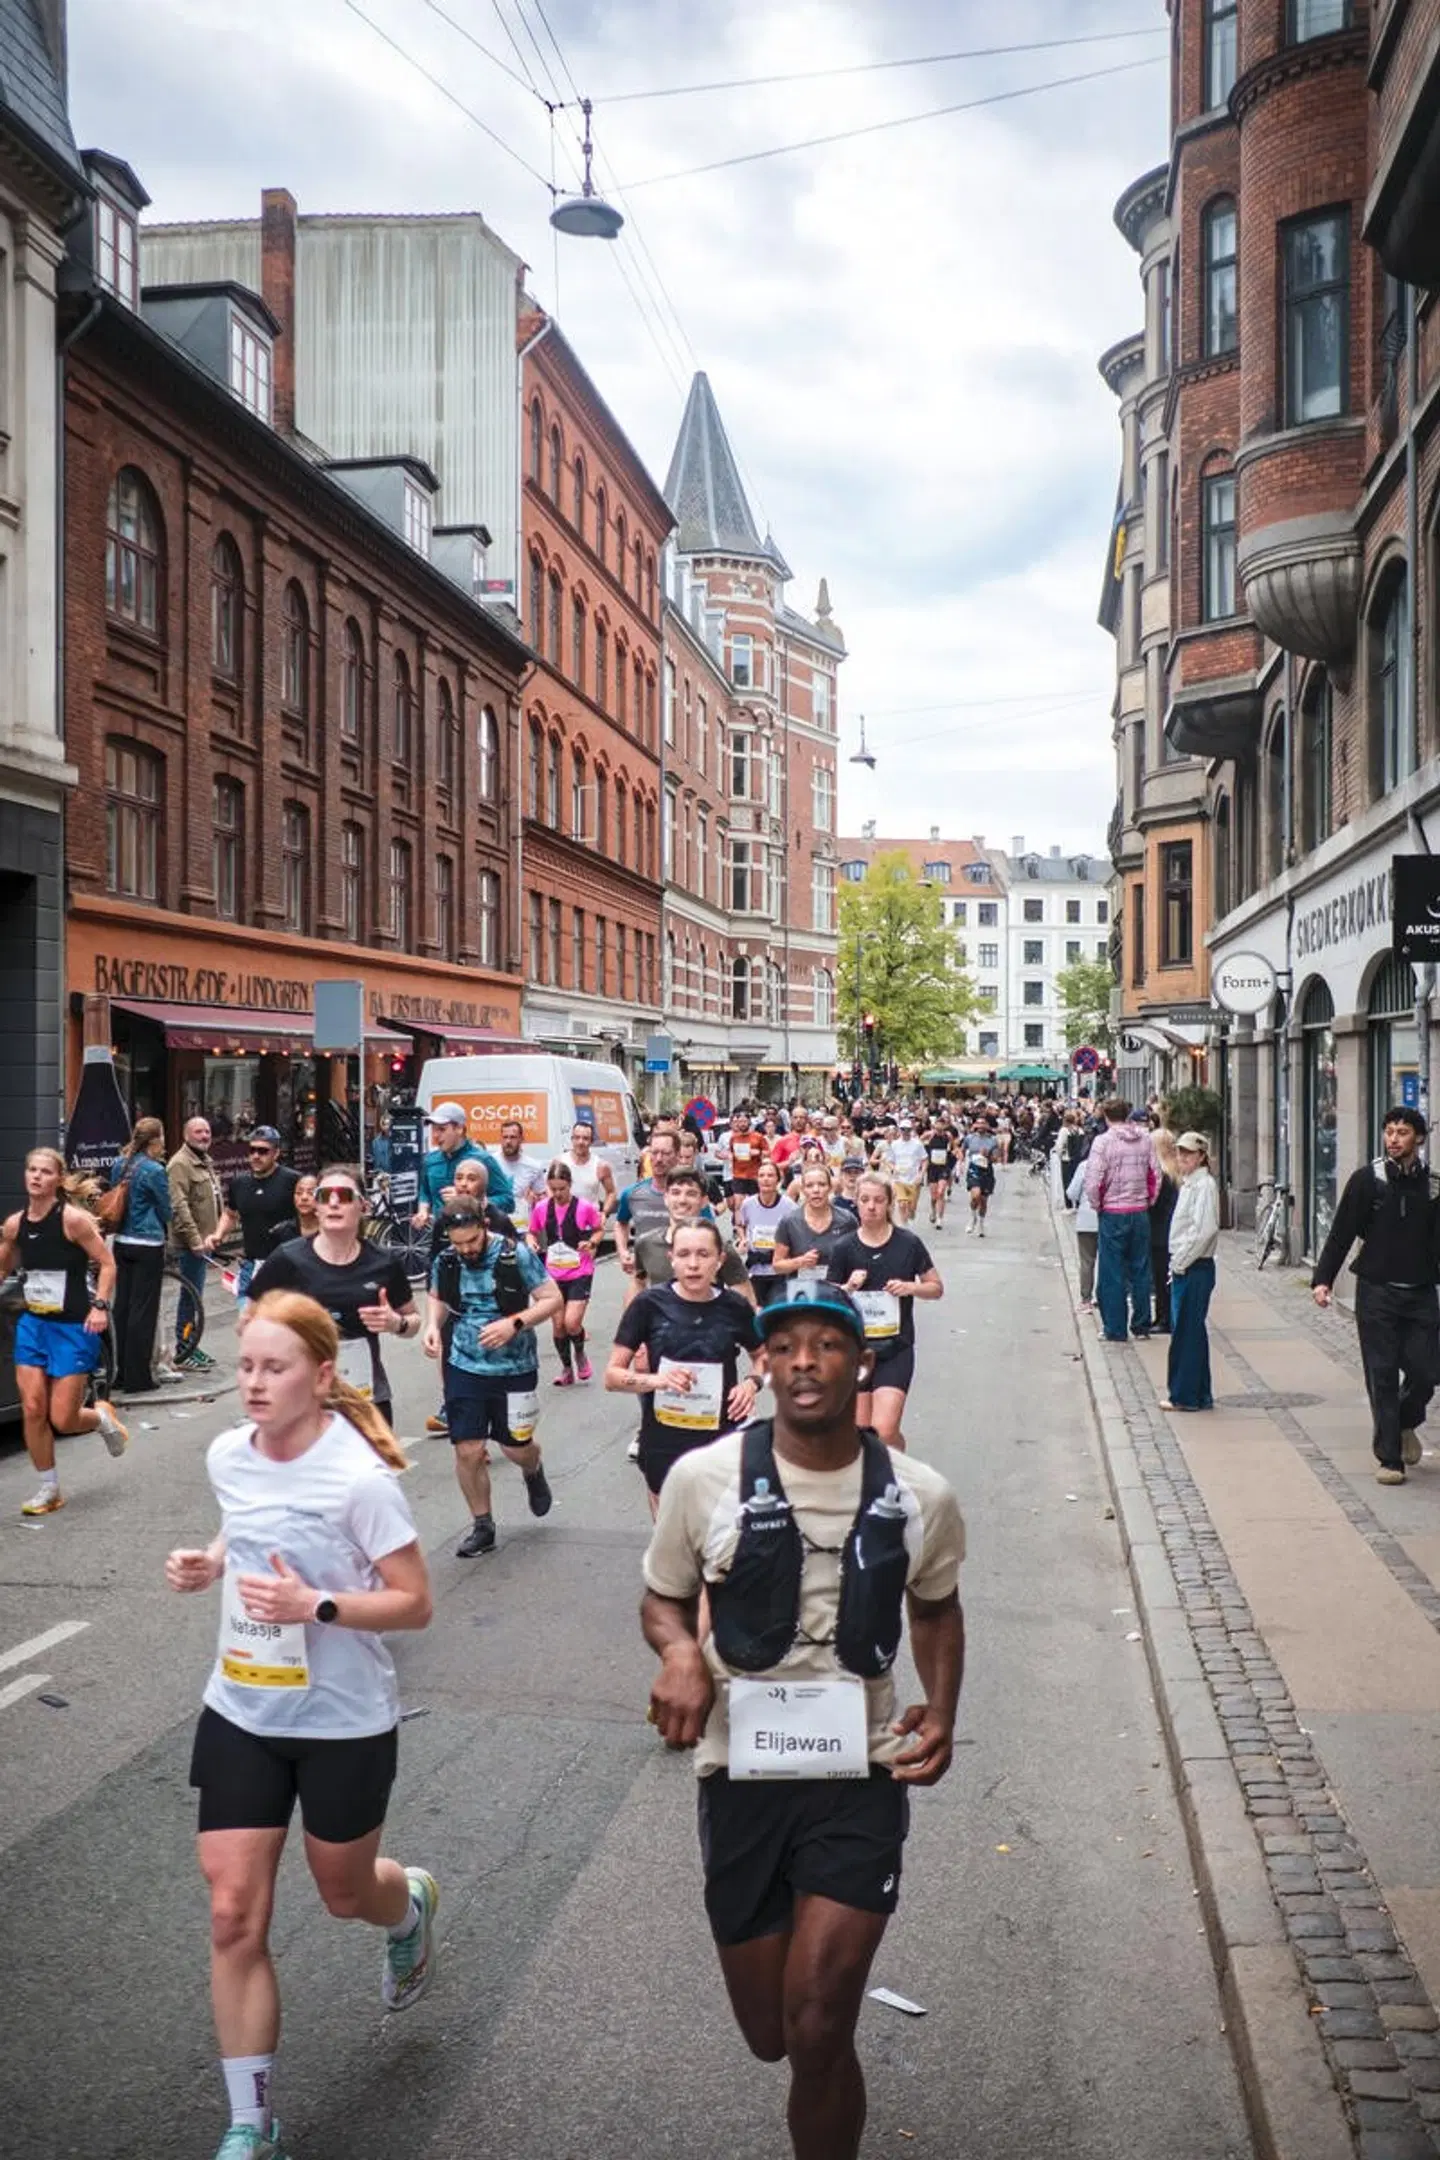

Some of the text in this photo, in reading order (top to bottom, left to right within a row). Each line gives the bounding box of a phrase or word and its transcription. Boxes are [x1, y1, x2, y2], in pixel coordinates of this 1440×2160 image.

[1405, 924, 1440, 935] AKUS
[95, 954, 228, 1003] BAGERSTRÆDE
[1222, 975, 1271, 989] Form+
[471, 1104, 538, 1121] OSCAR
[755, 1731, 842, 1755] Elijawan
